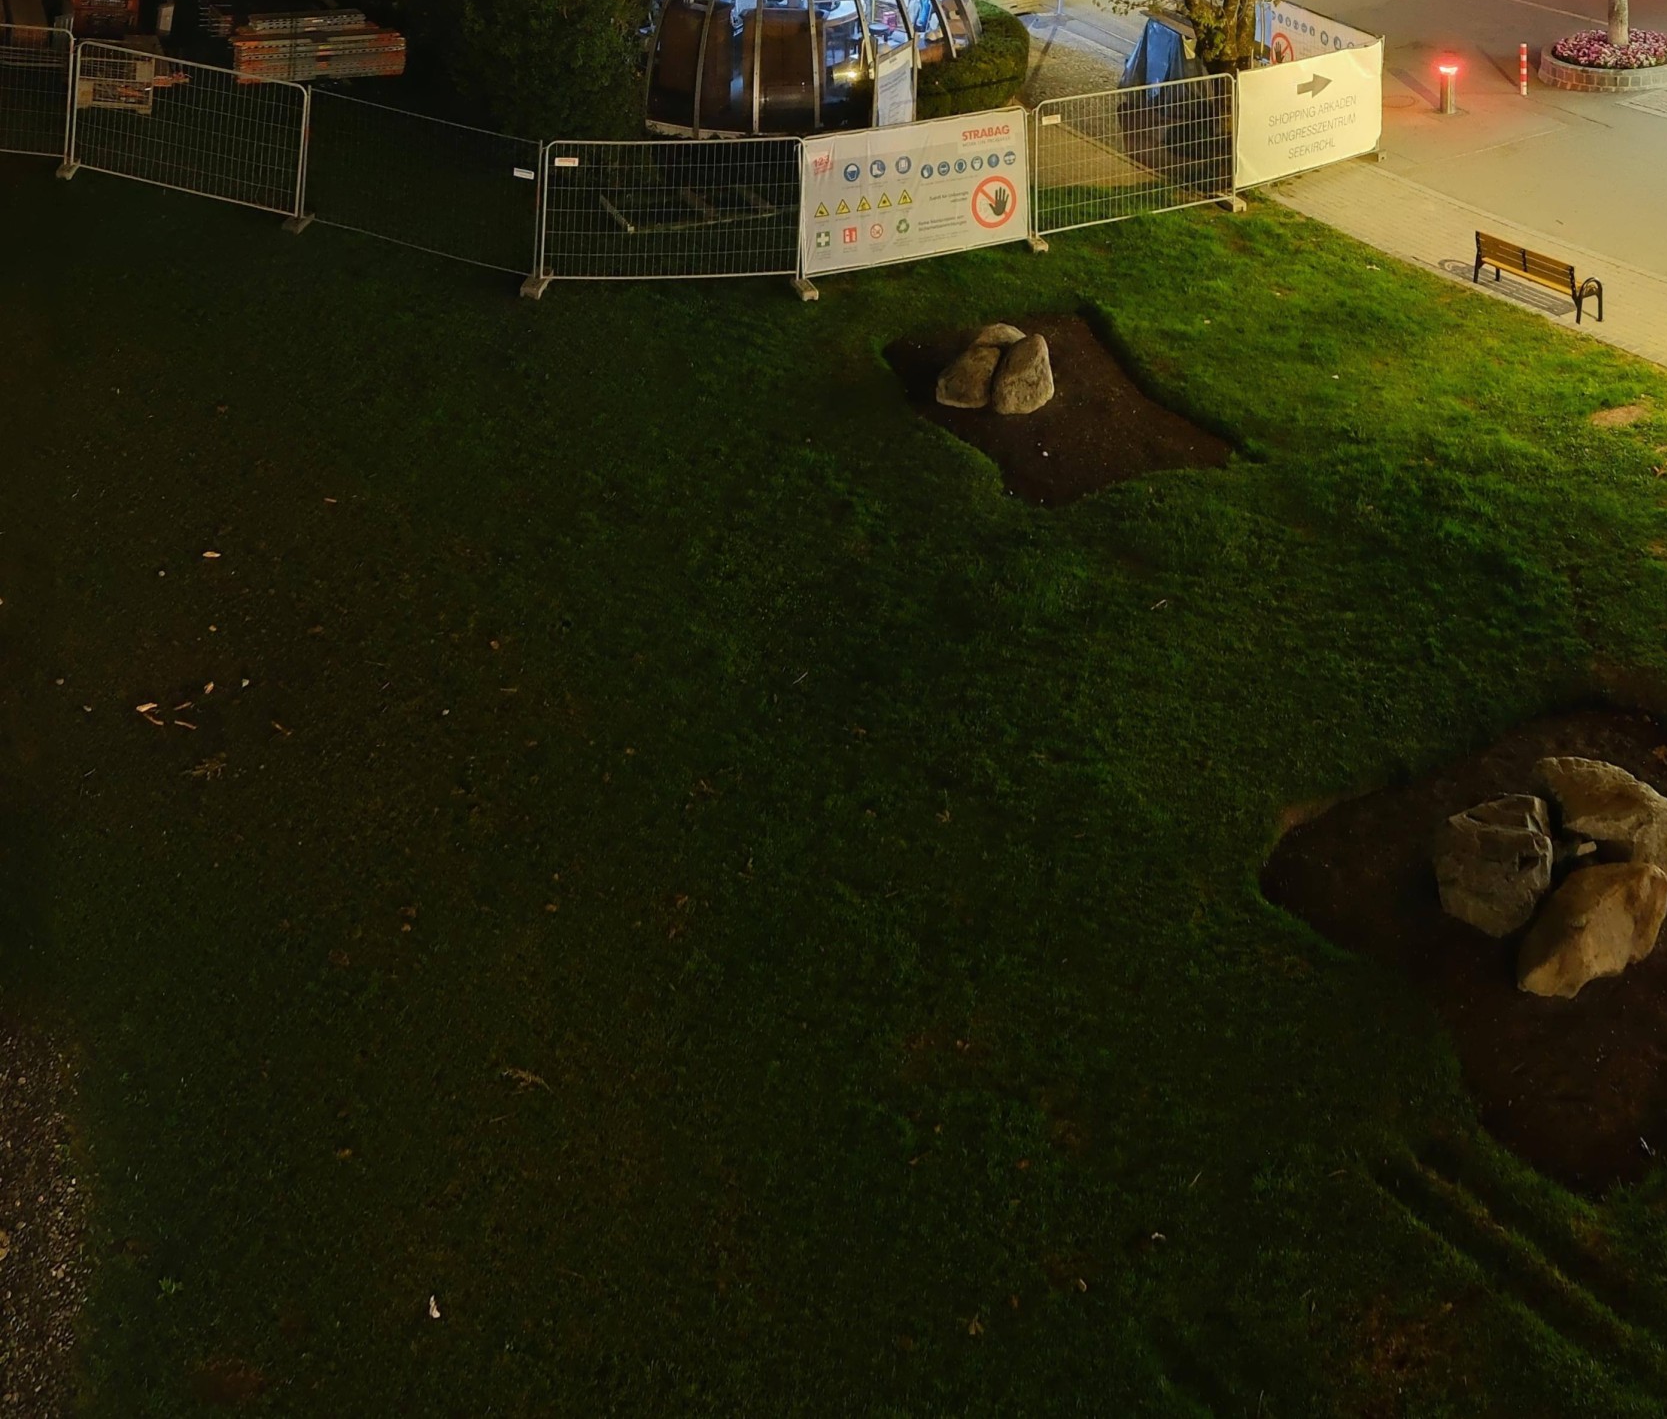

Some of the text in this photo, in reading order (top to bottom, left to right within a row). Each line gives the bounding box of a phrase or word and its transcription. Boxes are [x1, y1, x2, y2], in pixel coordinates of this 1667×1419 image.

[1268, 95, 1357, 128] SHOPPING ARKADEN
[962, 124, 1010, 141] STRABAG
[1267, 113, 1357, 146] KONGRESSZENTRUM
[1288, 138, 1336, 159] SEEKIRCHL
